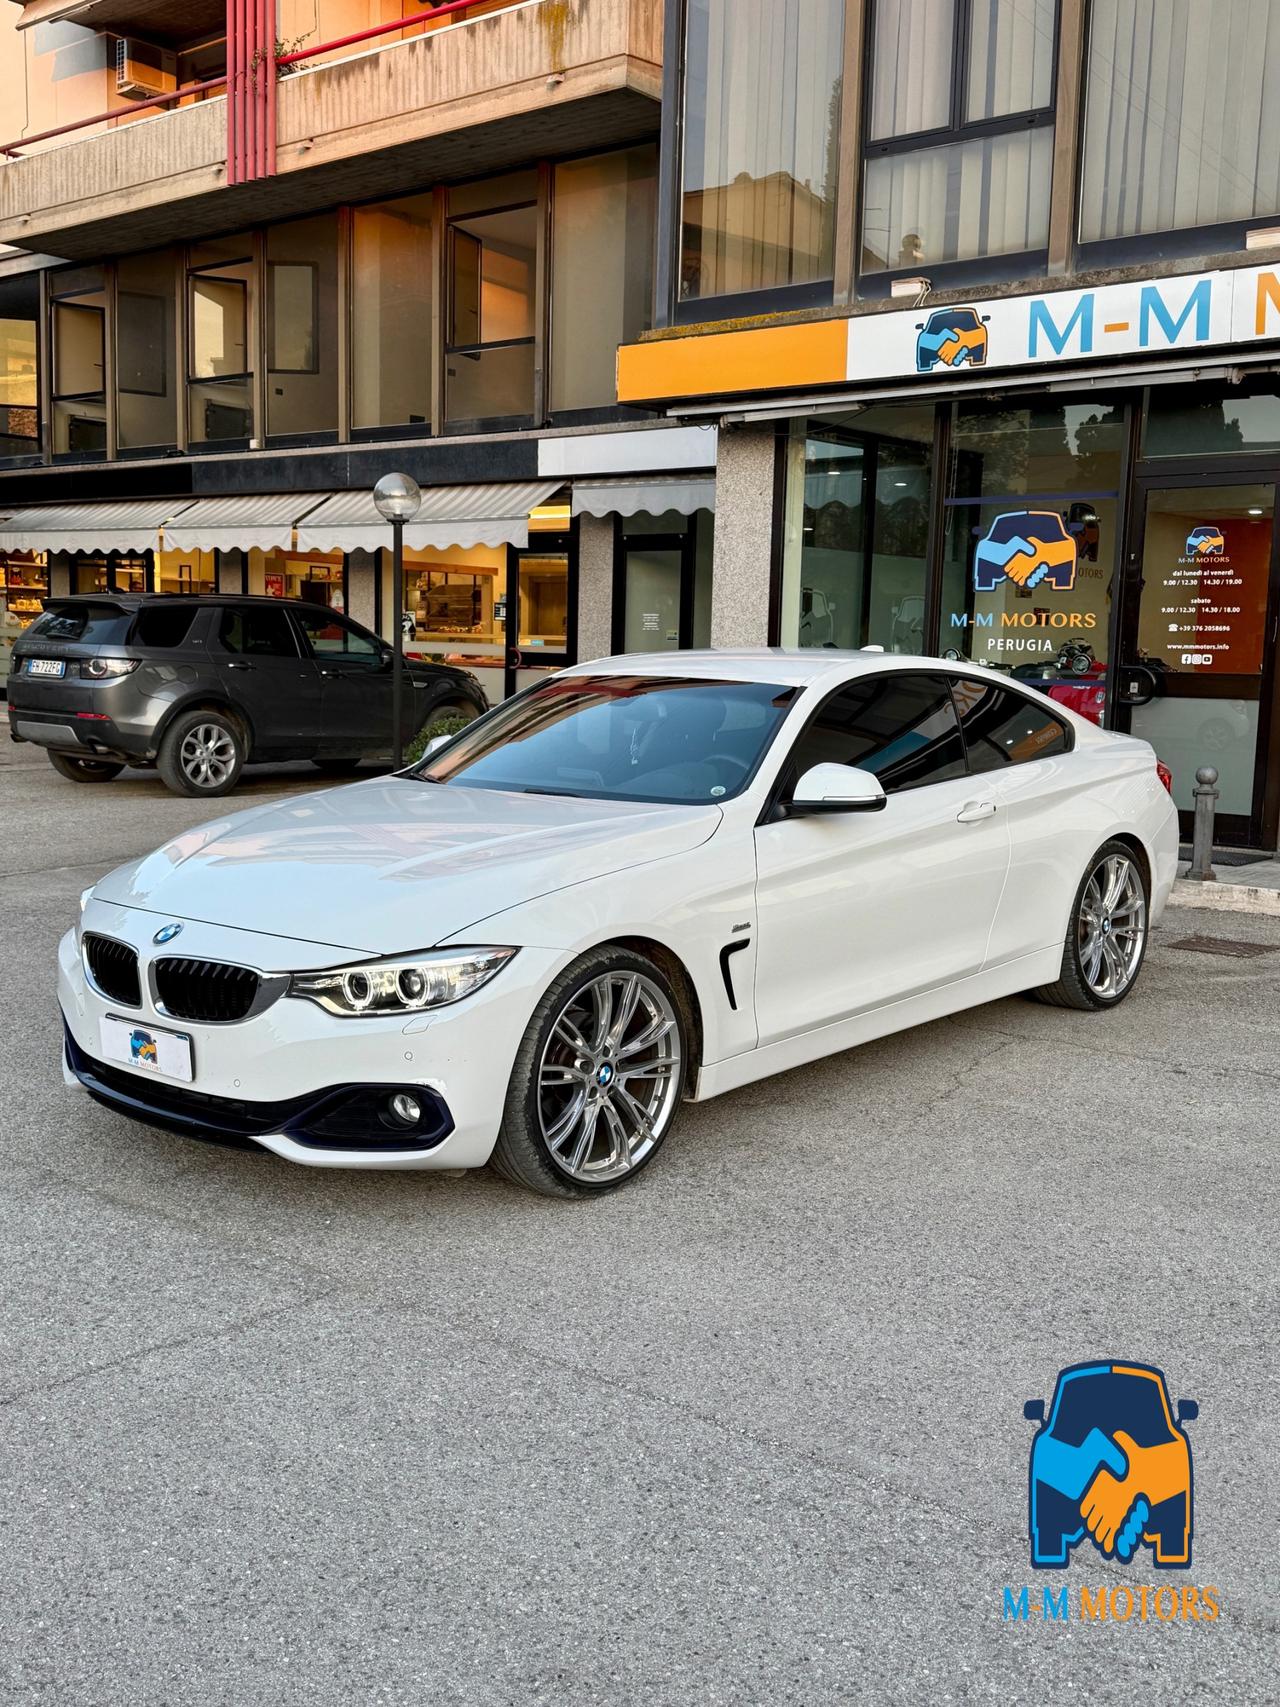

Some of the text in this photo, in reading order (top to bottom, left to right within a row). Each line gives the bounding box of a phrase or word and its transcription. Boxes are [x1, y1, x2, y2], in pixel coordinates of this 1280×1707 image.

[1028, 279, 1212, 358] M-M
[1078, 567, 1104, 579] OTORS
[951, 612, 1097, 628] M-M MOTORS
[987, 638, 1053, 651] PERUGIA
